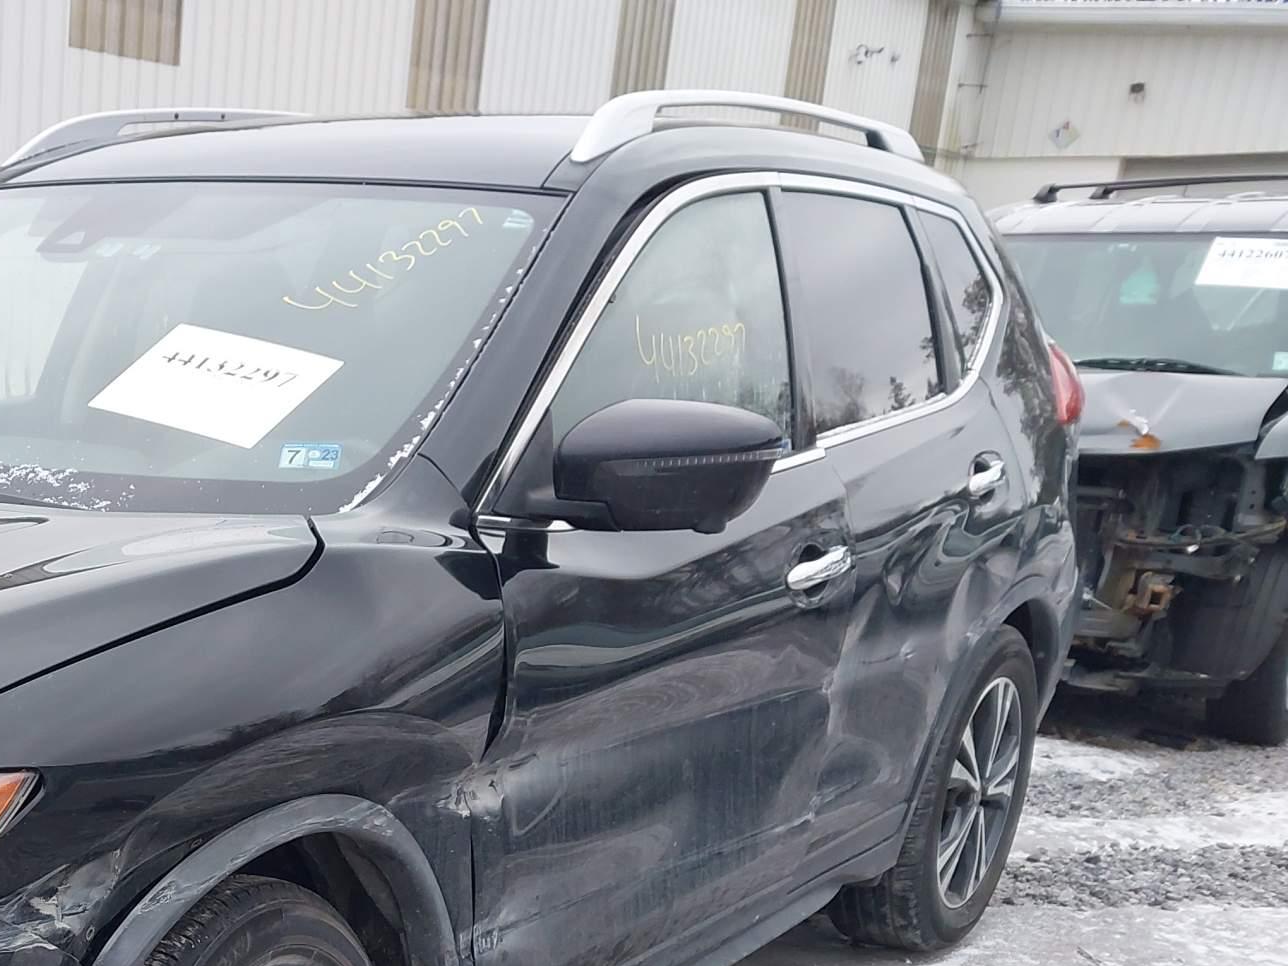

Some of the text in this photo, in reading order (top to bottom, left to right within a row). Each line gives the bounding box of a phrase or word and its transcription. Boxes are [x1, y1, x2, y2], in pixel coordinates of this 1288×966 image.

[283, 207, 484, 310] 44132297
[162, 352, 299, 388] 44132297
[635, 314, 746, 384] 44132297
[287, 449, 302, 465] 7
[320, 448, 339, 461] 23
